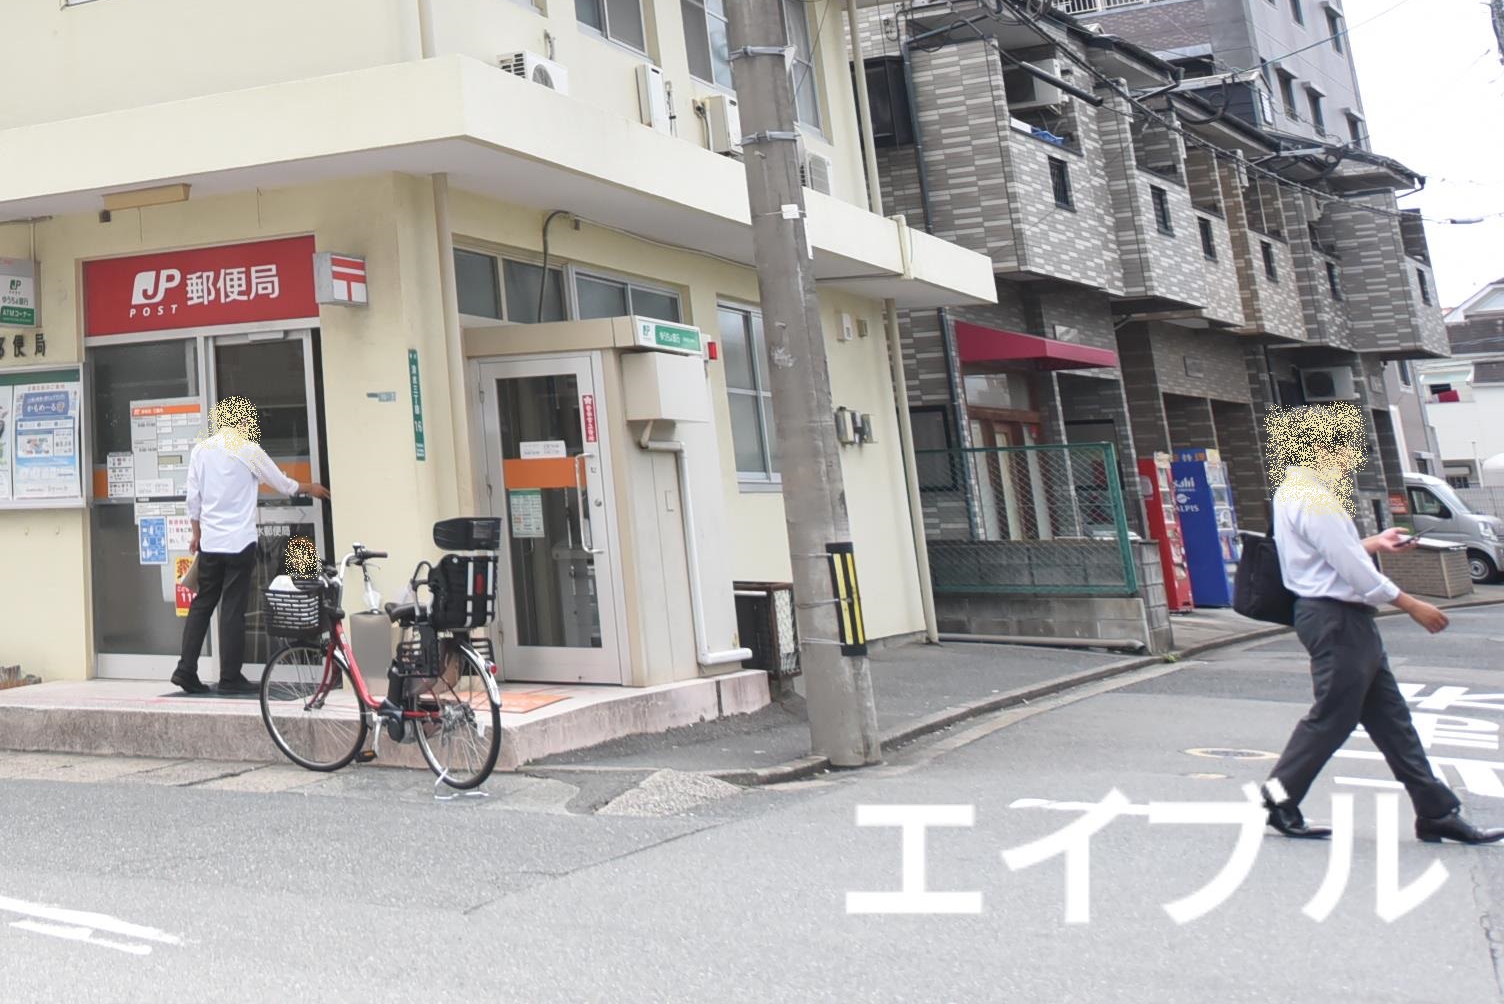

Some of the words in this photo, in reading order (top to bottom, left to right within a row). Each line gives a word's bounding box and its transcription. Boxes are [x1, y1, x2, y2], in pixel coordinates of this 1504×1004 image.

[185, 264, 280, 306] 郵便局
[2, 308, 32, 318] ATMコーナー
[129, 304, 178, 318] POST
